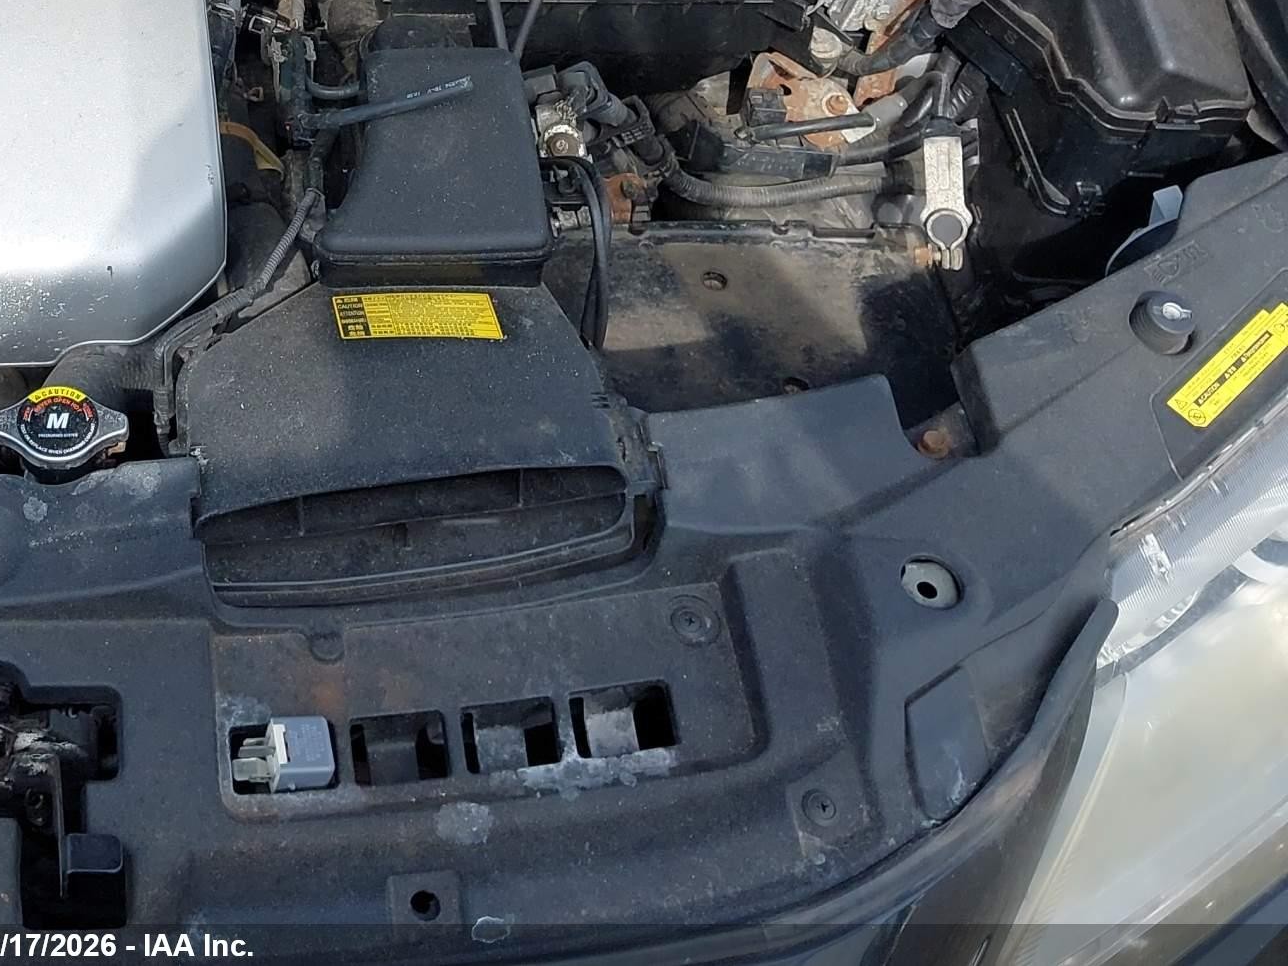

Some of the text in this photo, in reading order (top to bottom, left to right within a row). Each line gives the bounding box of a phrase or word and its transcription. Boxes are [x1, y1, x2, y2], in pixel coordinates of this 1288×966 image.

[42, 388, 82, 400] CAUTION
[53, 397, 72, 405] OPEN
[46, 413, 70, 429] M
